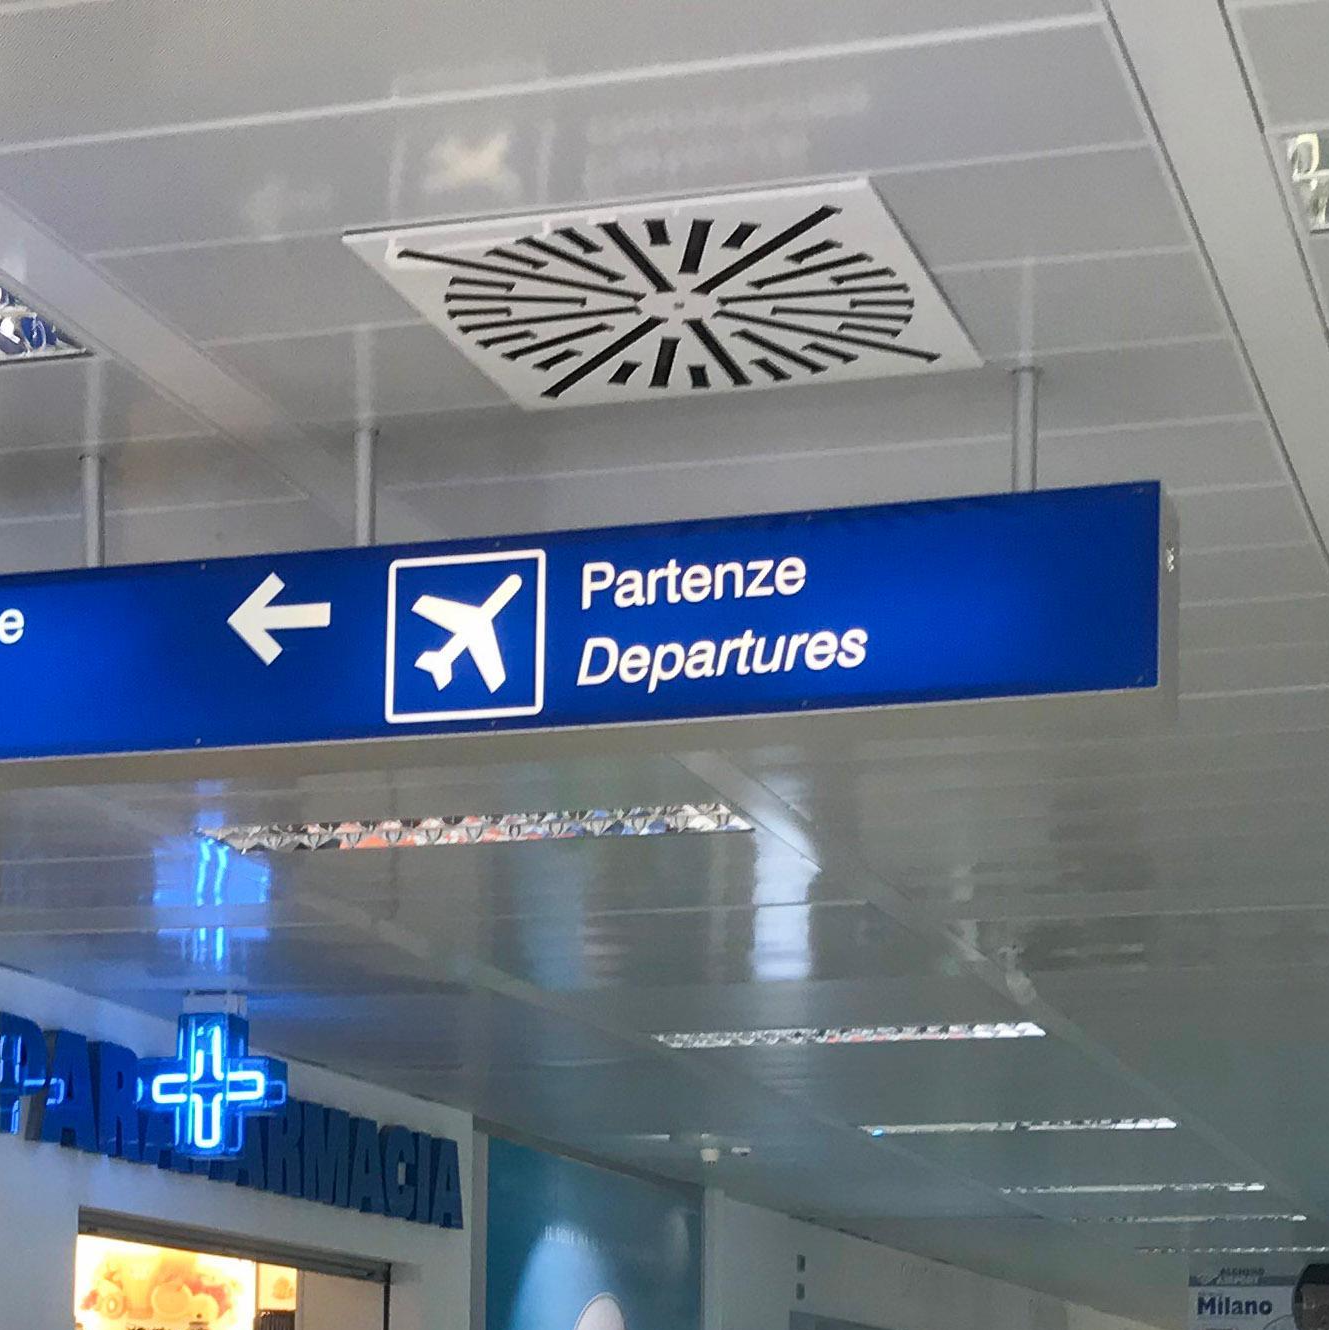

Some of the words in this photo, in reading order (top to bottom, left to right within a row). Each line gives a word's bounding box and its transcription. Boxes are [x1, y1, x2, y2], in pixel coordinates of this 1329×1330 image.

[581, 556, 807, 610] Partenze
[576, 628, 869, 694] Departures
[1196, 1296, 1273, 1316] Milano
